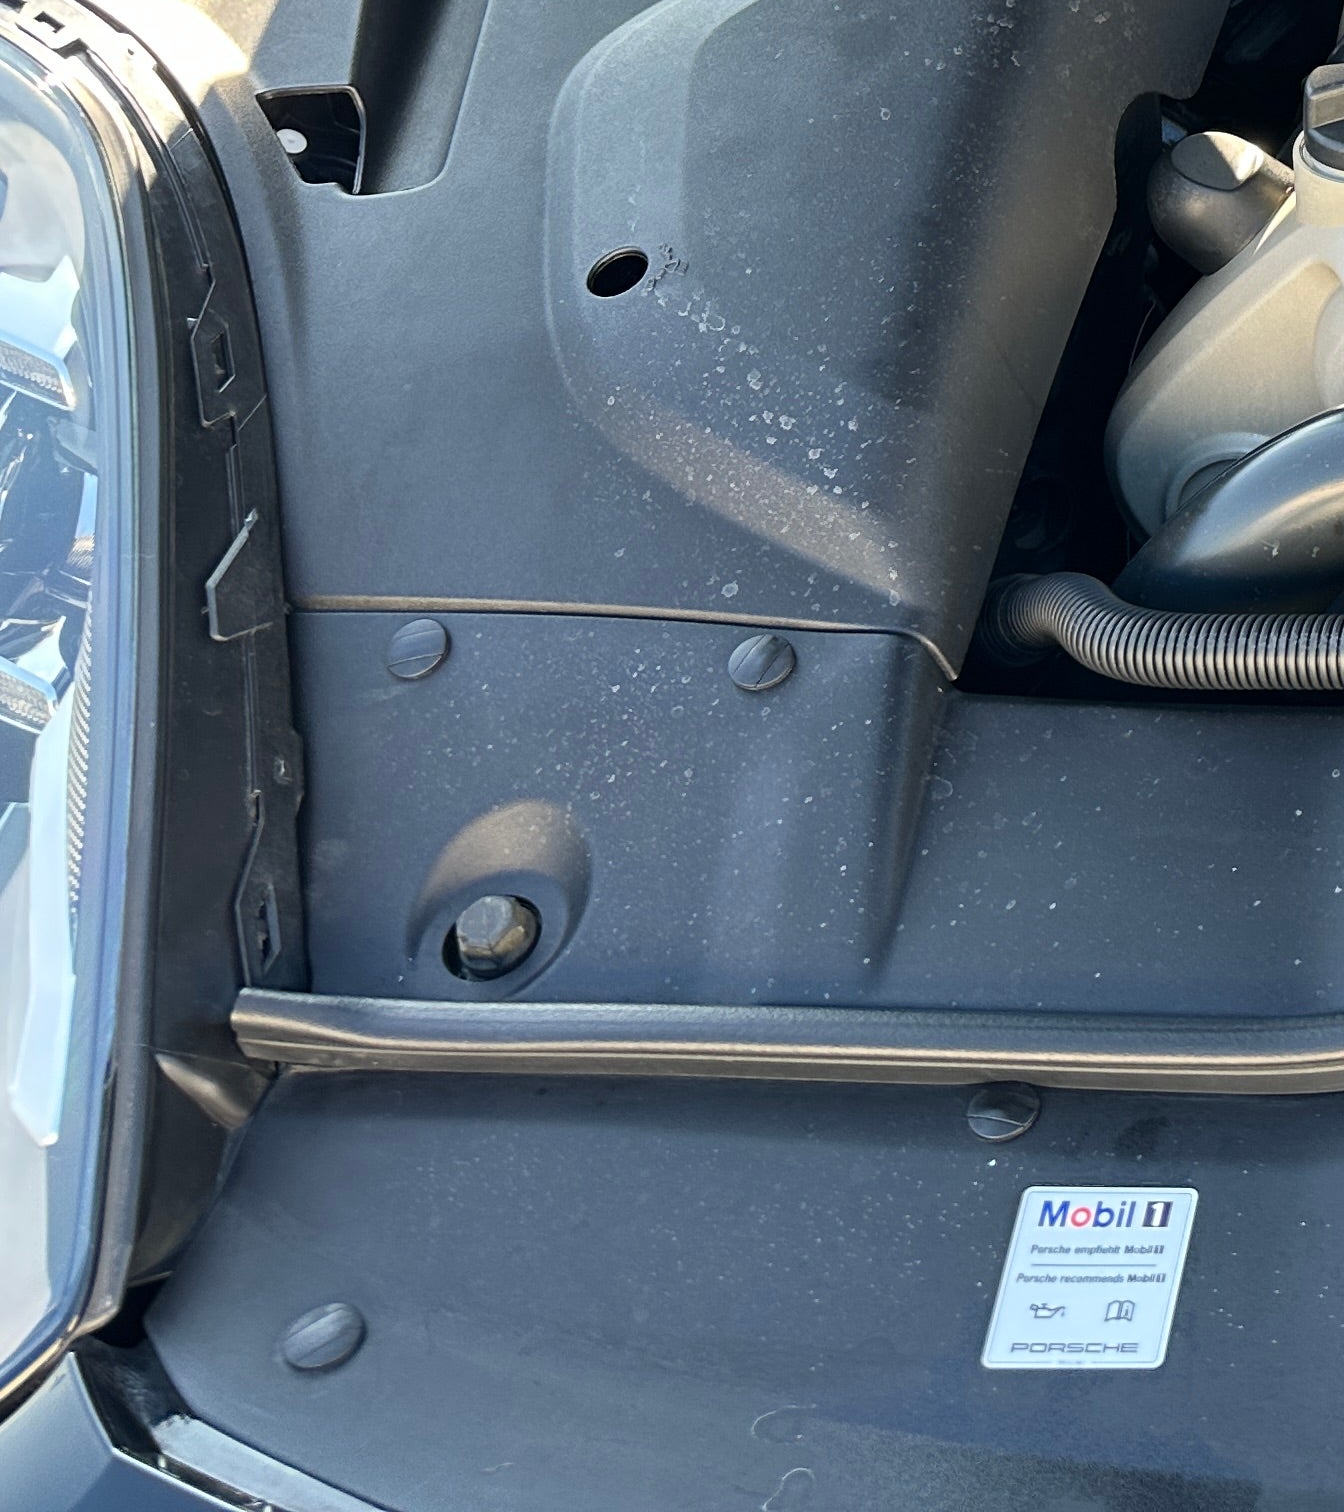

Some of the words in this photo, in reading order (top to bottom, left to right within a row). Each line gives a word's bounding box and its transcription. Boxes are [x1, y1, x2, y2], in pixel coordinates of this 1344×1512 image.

[1037, 1200, 1137, 1228] Mobil
[1030, 1244, 1071, 1254] Porsche
[1074, 1244, 1121, 1255] empfiehlt
[1124, 1245, 1153, 1254] Mobil
[1016, 1273, 1057, 1283] Porsche
[1060, 1273, 1124, 1283] recommends
[1127, 1274, 1155, 1283] Mobil
[1010, 1342, 1139, 1353] PORSCHE
